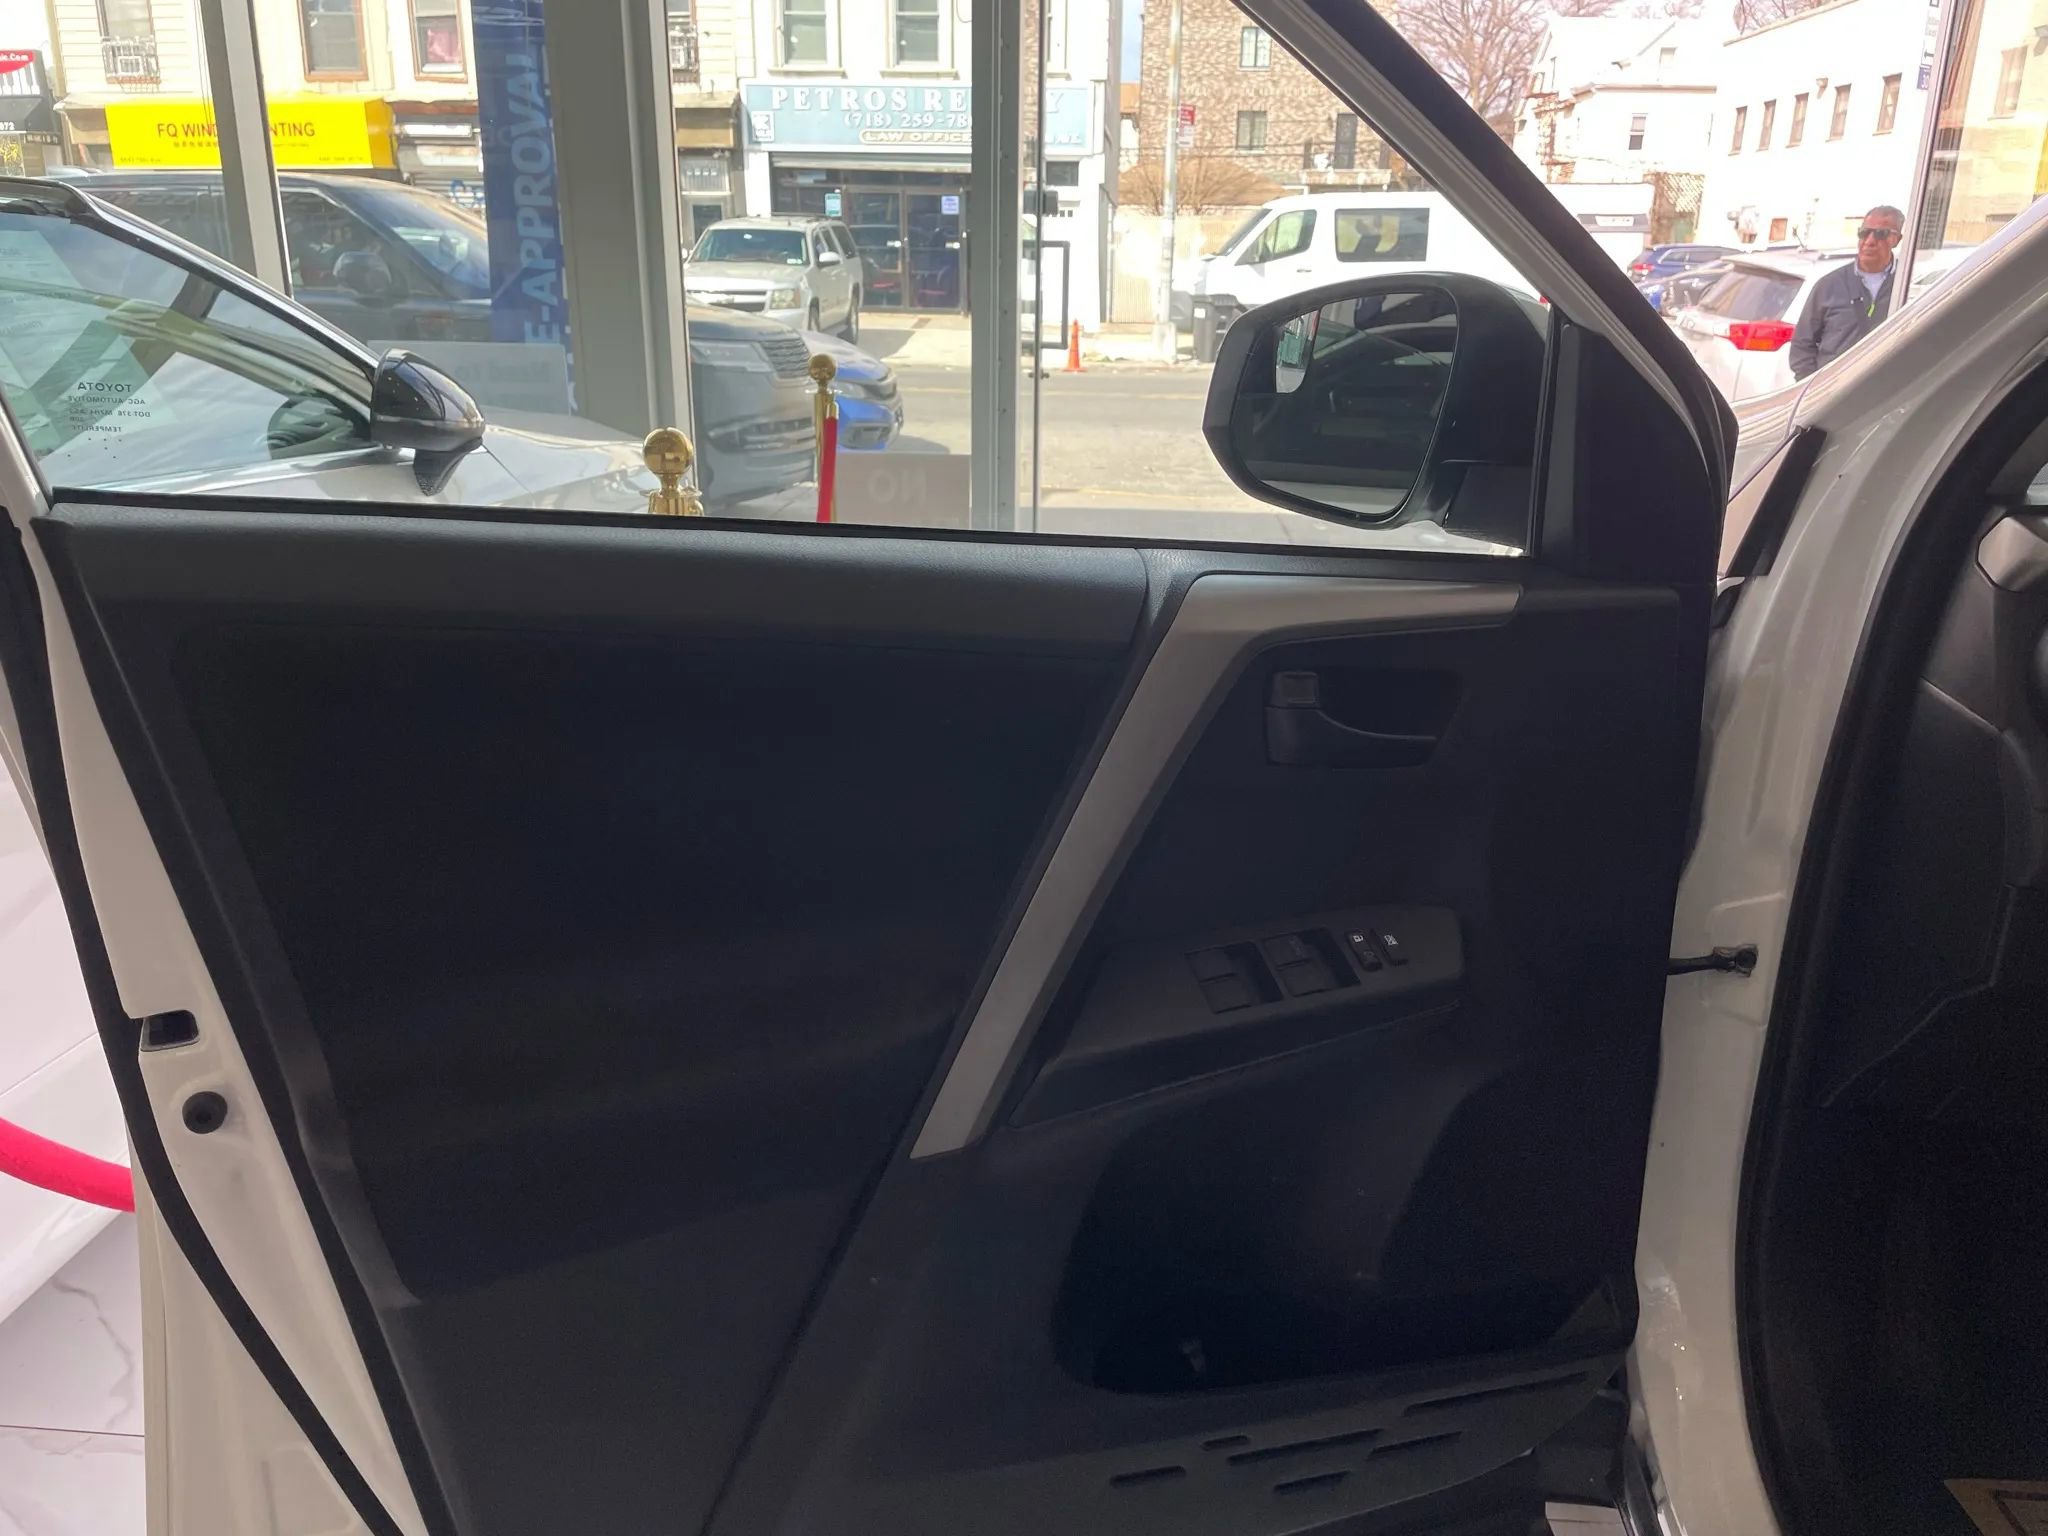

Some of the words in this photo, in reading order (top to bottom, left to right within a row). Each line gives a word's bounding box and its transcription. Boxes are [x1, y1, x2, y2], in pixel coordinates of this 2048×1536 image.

[772, 87, 908, 111] PETROS
[843, 112, 893, 129] (718)
[901, 113, 972, 128] 259-78
[157, 123, 178, 138] FQ
[863, 131, 905, 142] LAW
